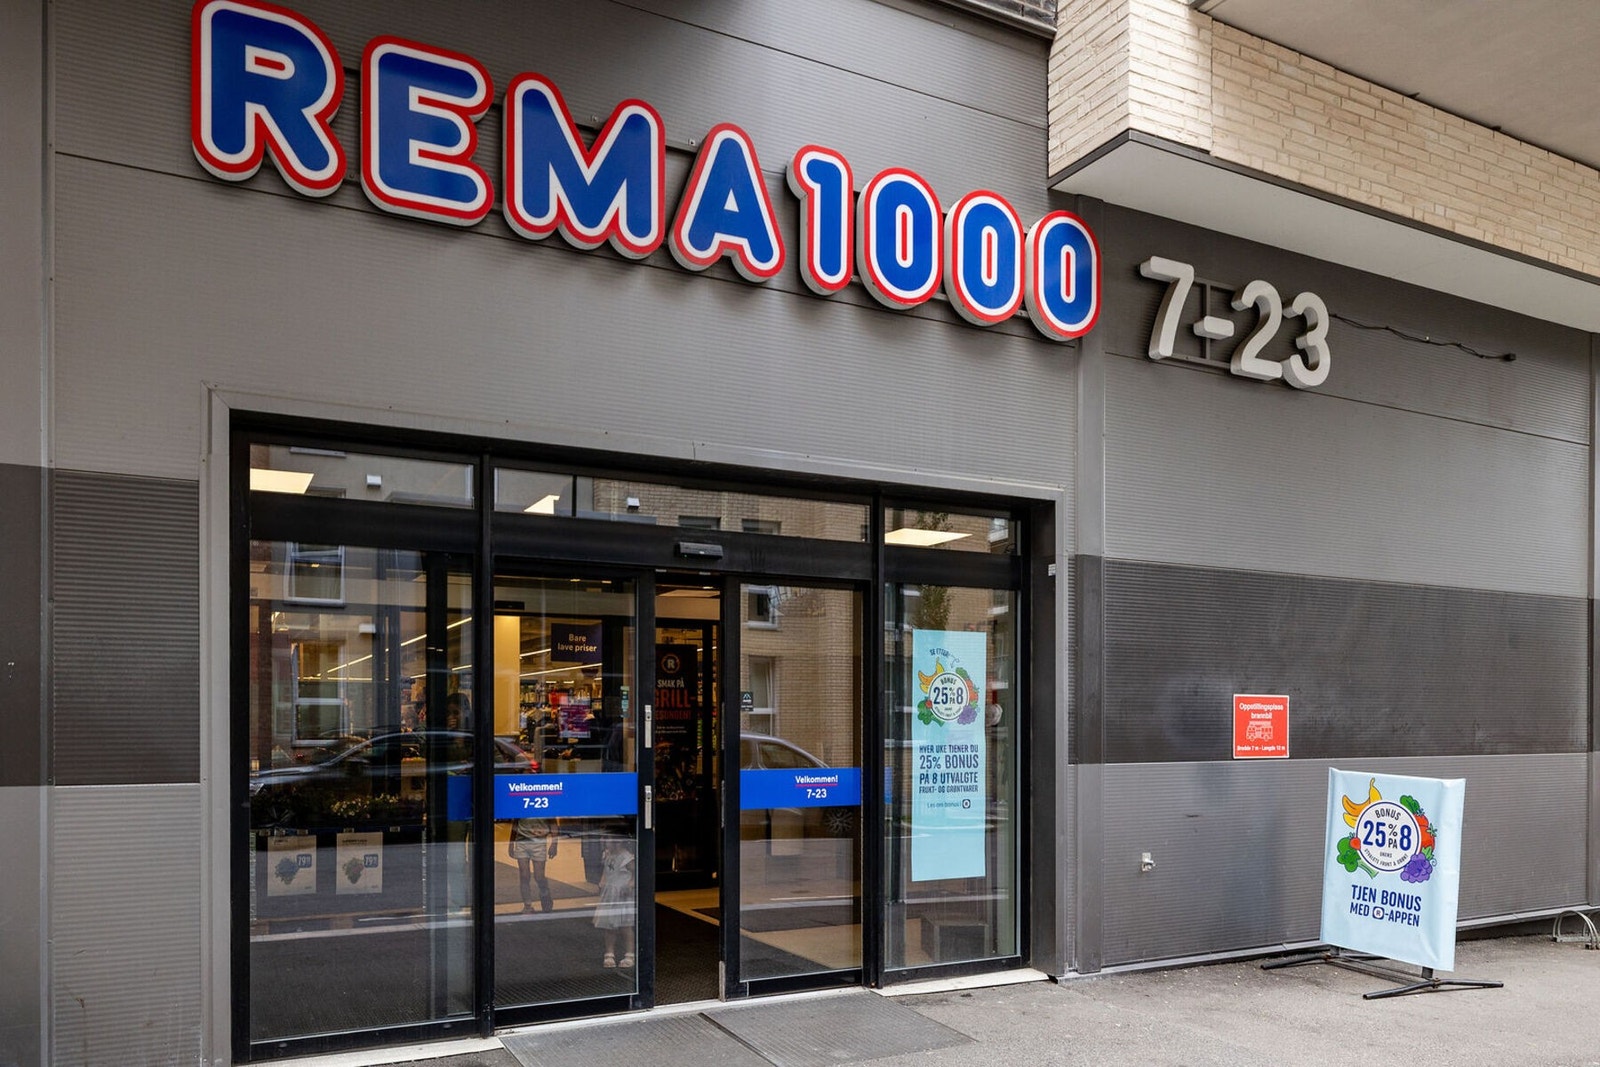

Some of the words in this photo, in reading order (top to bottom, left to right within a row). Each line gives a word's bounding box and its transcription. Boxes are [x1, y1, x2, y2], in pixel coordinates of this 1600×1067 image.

[1140, 256, 1331, 388] 7-23
[568, 633, 587, 642] Bare
[557, 642, 574, 651] lave
[574, 643, 598, 653] priser
[657, 679, 676, 688] SMAK
[956, 686, 964, 705] 8
[918, 744, 934, 754] HVER
[935, 744, 947, 753] UKE
[970, 744, 979, 753] DU
[919, 754, 942, 769] 25%
[944, 754, 979, 769] BONUS
[794, 774, 839, 784] Velkommen!
[919, 769, 930, 785] PÅ
[932, 772, 938, 785] 8
[940, 771, 978, 785] UTVALGTE
[508, 782, 563, 792] Velkommen!
[937, 785, 946, 793] OG
[806, 788, 827, 799] 7-23
[523, 797, 549, 809] 7-23
[1374, 807, 1402, 821] BONUS
[1399, 824, 1412, 851] 8
[1351, 884, 1377, 903] TJEN
[1380, 890, 1422, 912] BONUS
[1349, 901, 1370, 917] MED
